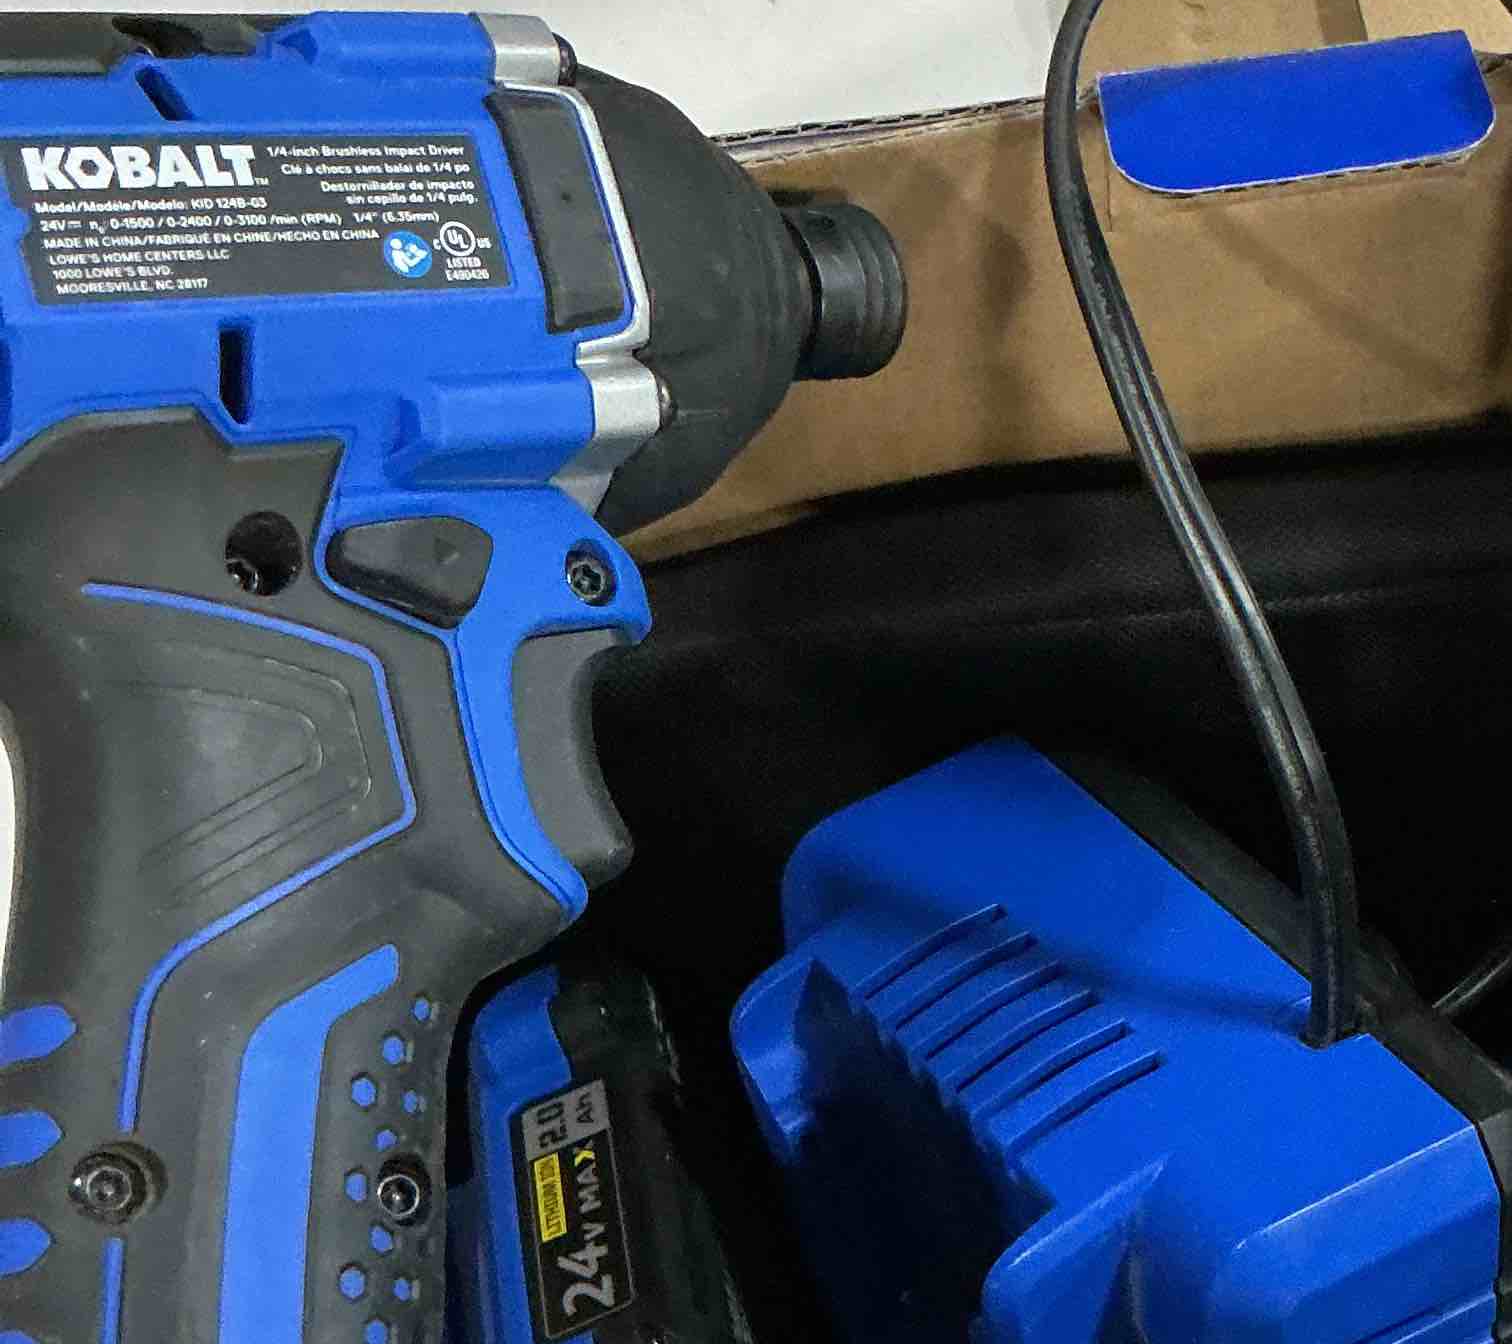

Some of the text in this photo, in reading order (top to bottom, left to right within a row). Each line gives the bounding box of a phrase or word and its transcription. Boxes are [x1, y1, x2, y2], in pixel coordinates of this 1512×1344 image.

[320, 144, 382, 157] Brushless
[383, 144, 426, 158] Impact
[428, 143, 464, 156] Driver
[20, 144, 256, 191] KOBALT
[415, 162, 432, 173] de
[453, 163, 471, 175] po
[408, 179, 425, 191] de
[426, 179, 475, 192] impacto
[190, 198, 214, 210] KID
[408, 192, 425, 204] de
[42, 237, 83, 250] MADE
[84, 236, 100, 248] IN
[341, 227, 381, 241] CHINA
[103, 251, 142, 263] HOME
[143, 249, 203, 262] CENTERS
[155, 278, 176, 290] NC
[573, 1138, 603, 1216] MAX
